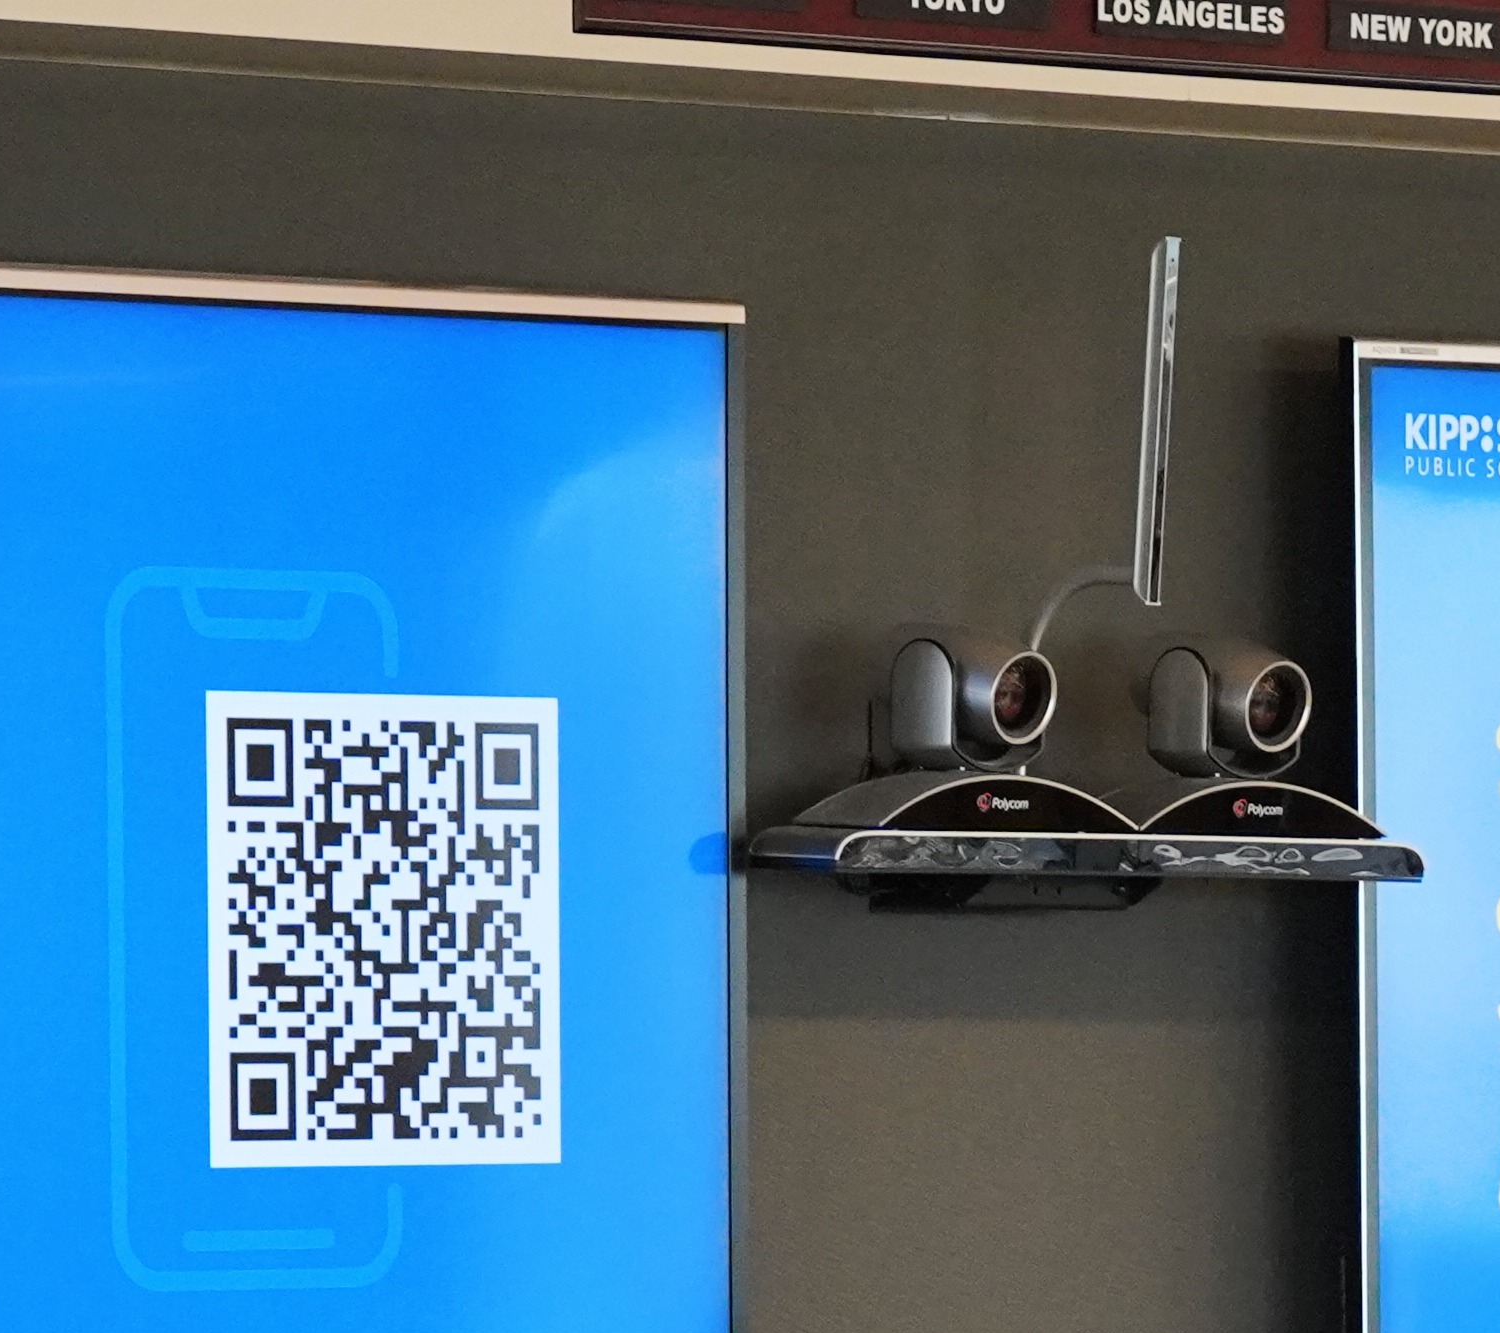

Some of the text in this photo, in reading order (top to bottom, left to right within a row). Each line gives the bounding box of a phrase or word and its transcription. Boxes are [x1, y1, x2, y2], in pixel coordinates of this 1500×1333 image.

[1098, 0, 1285, 34] LOS ANGELES
[1350, 12, 1494, 49] NEW YORK
[1404, 455, 1476, 477] PUBLIC
[991, 796, 1029, 811] Polycom
[1247, 803, 1284, 817] Polycom
